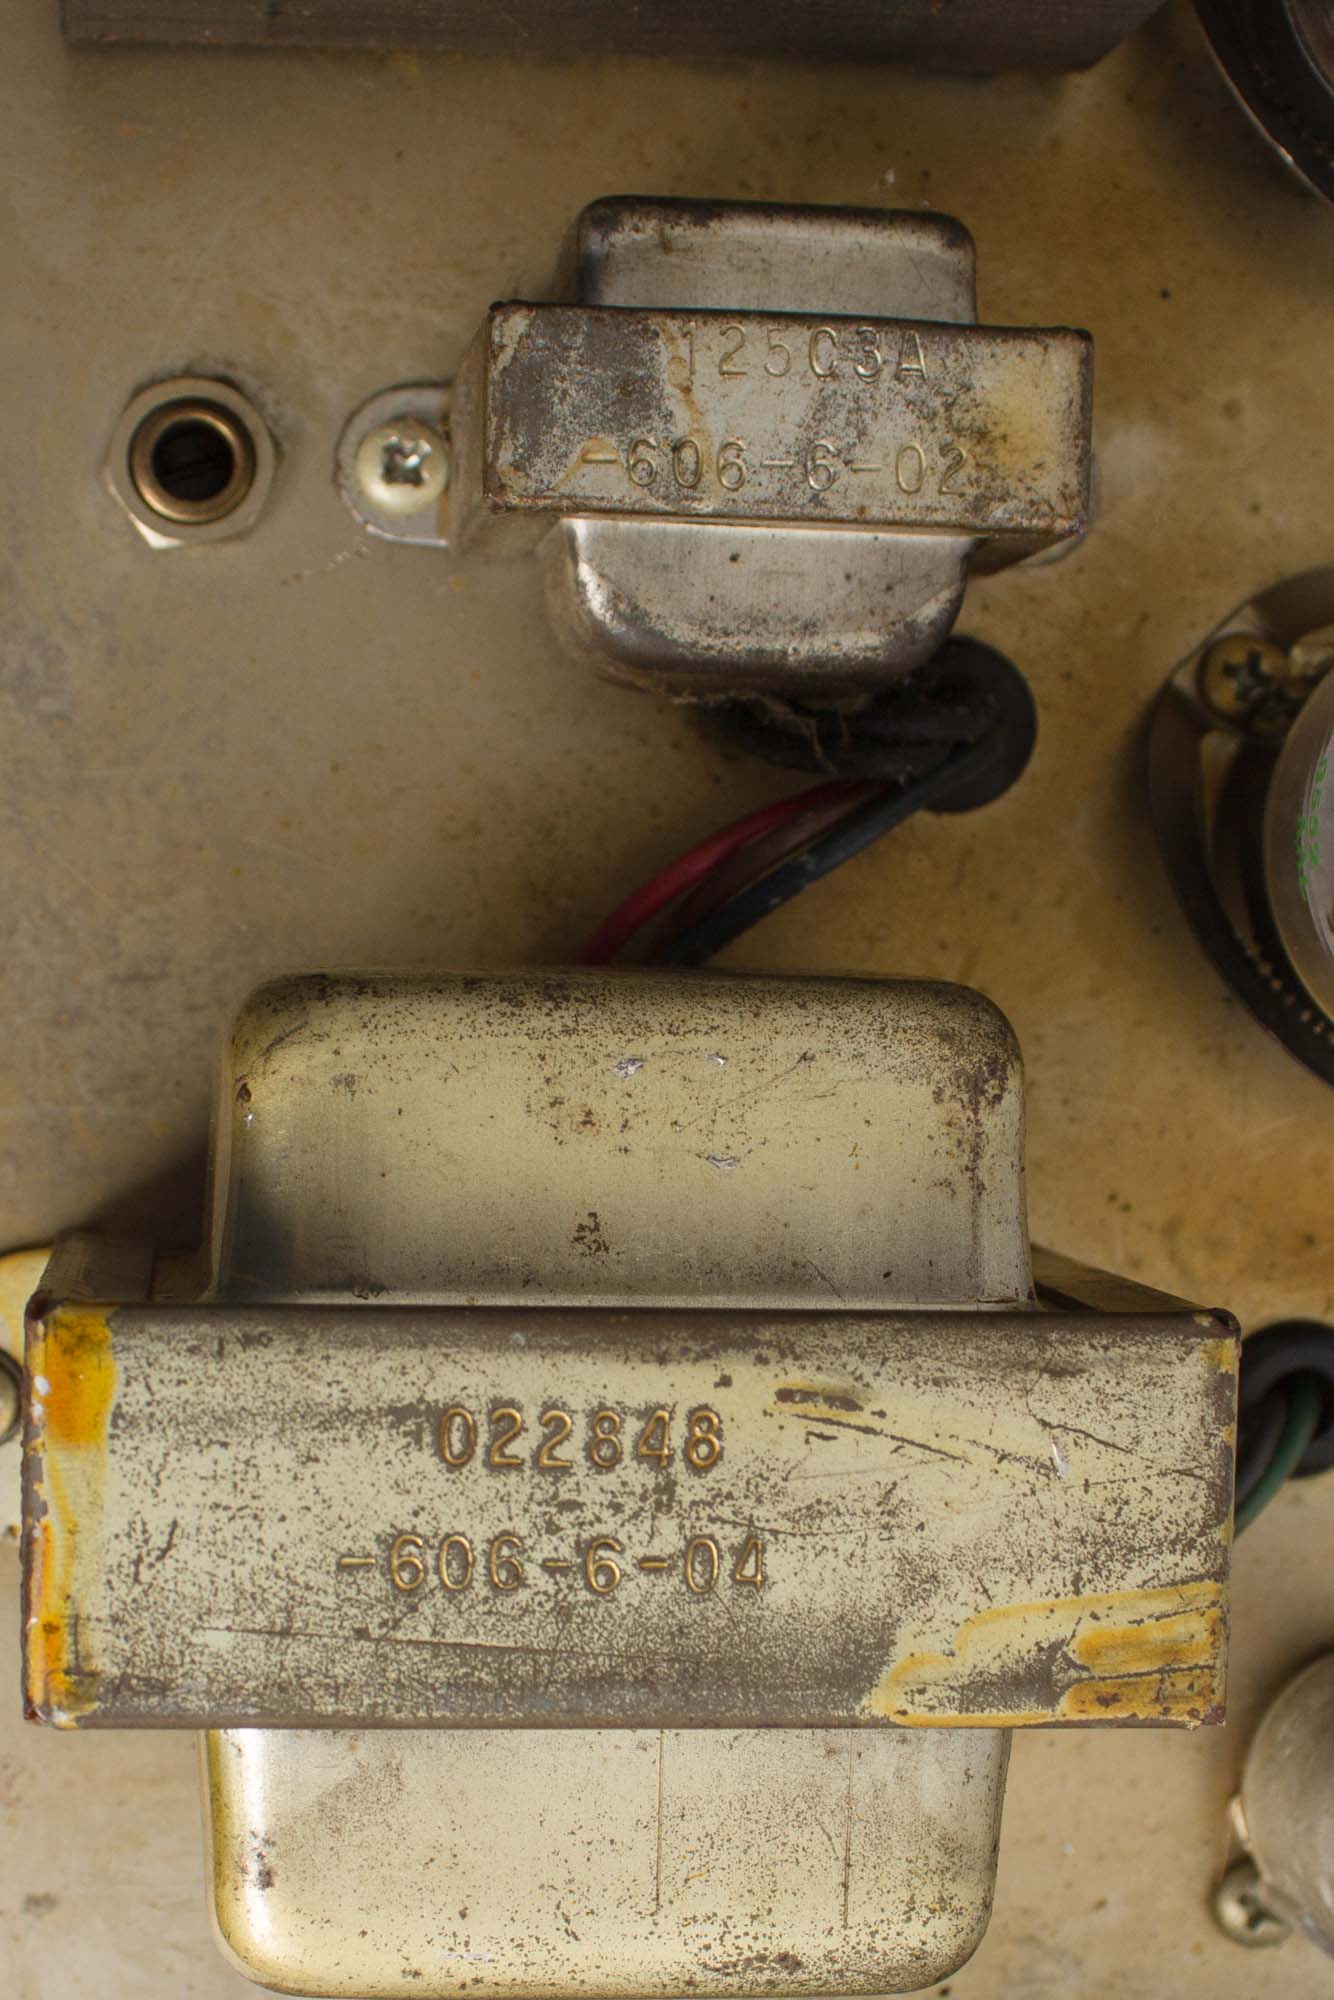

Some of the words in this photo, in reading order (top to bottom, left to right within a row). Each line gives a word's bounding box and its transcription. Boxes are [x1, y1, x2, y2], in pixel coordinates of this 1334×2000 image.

[682, 321, 928, 382] 125C3A
[581, 437, 968, 495] -606-6-02
[439, 1406, 721, 1468] 022848
[339, 1534, 767, 1594] -606-6-04
